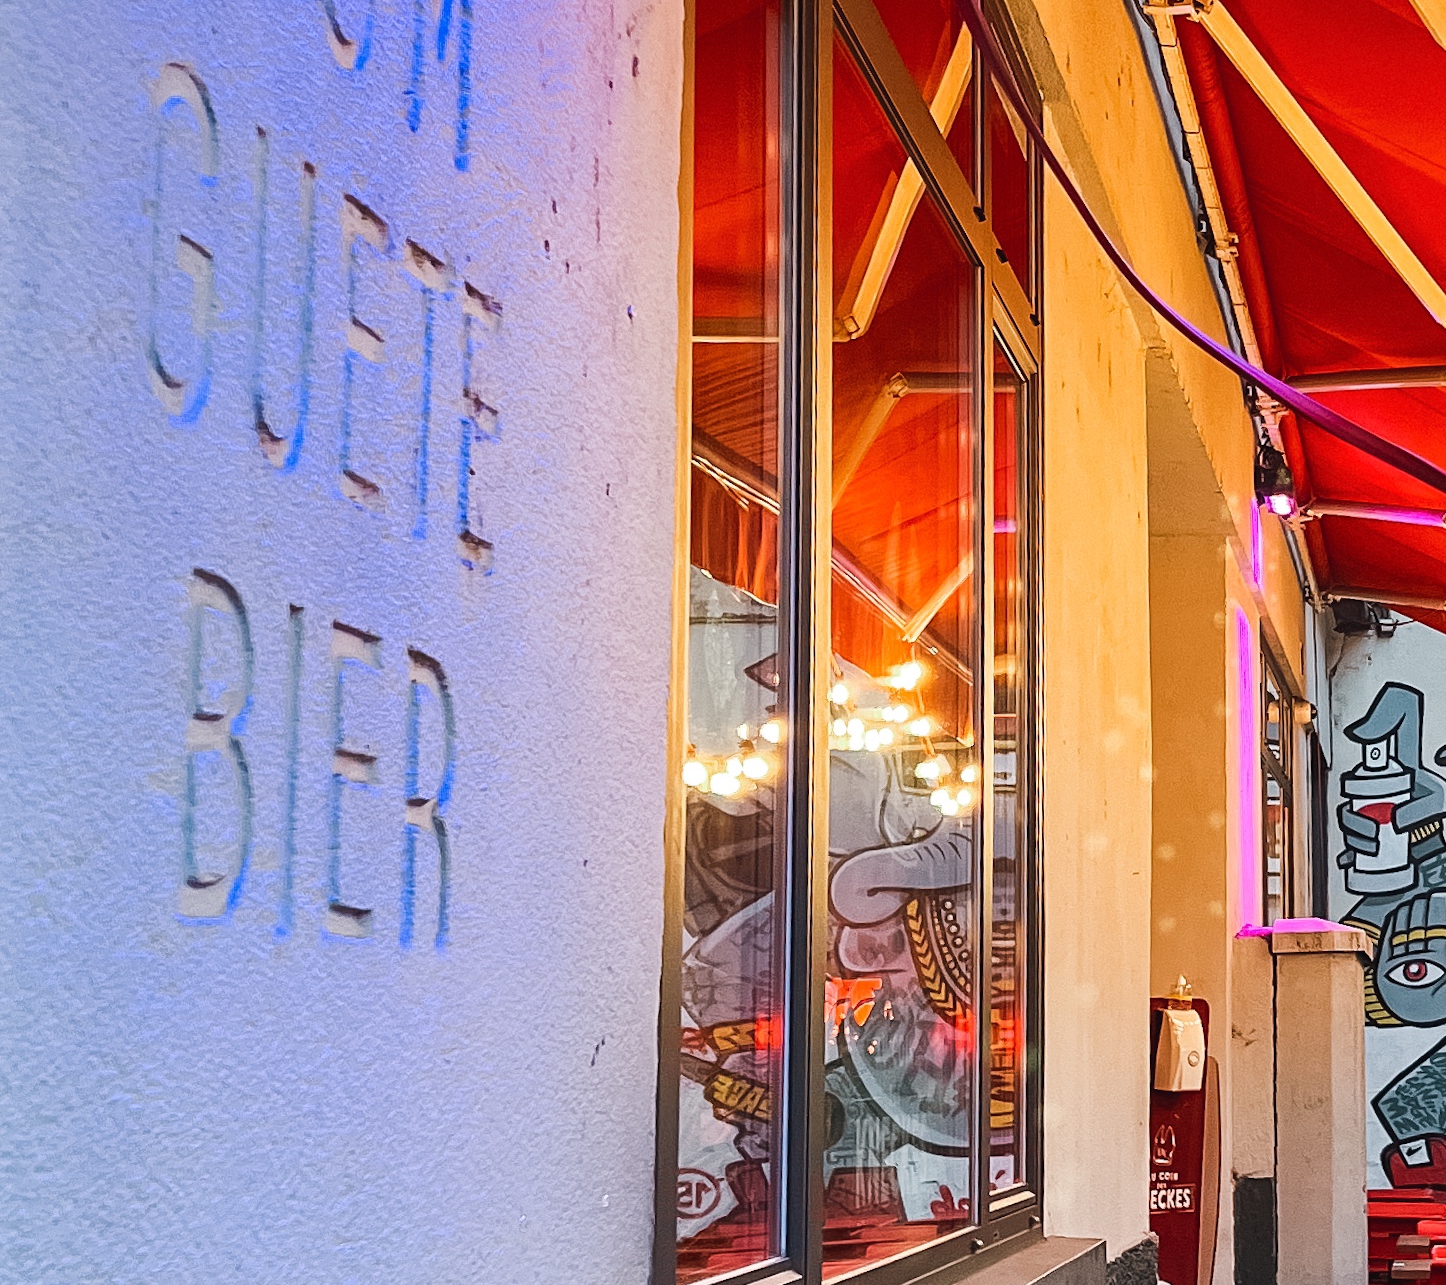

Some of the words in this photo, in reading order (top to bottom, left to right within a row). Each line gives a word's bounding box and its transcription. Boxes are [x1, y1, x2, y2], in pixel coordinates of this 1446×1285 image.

[146, 61, 503, 576] GUETE
[177, 567, 457, 954] BIER
[1150, 1188, 1191, 1210] ECKES
